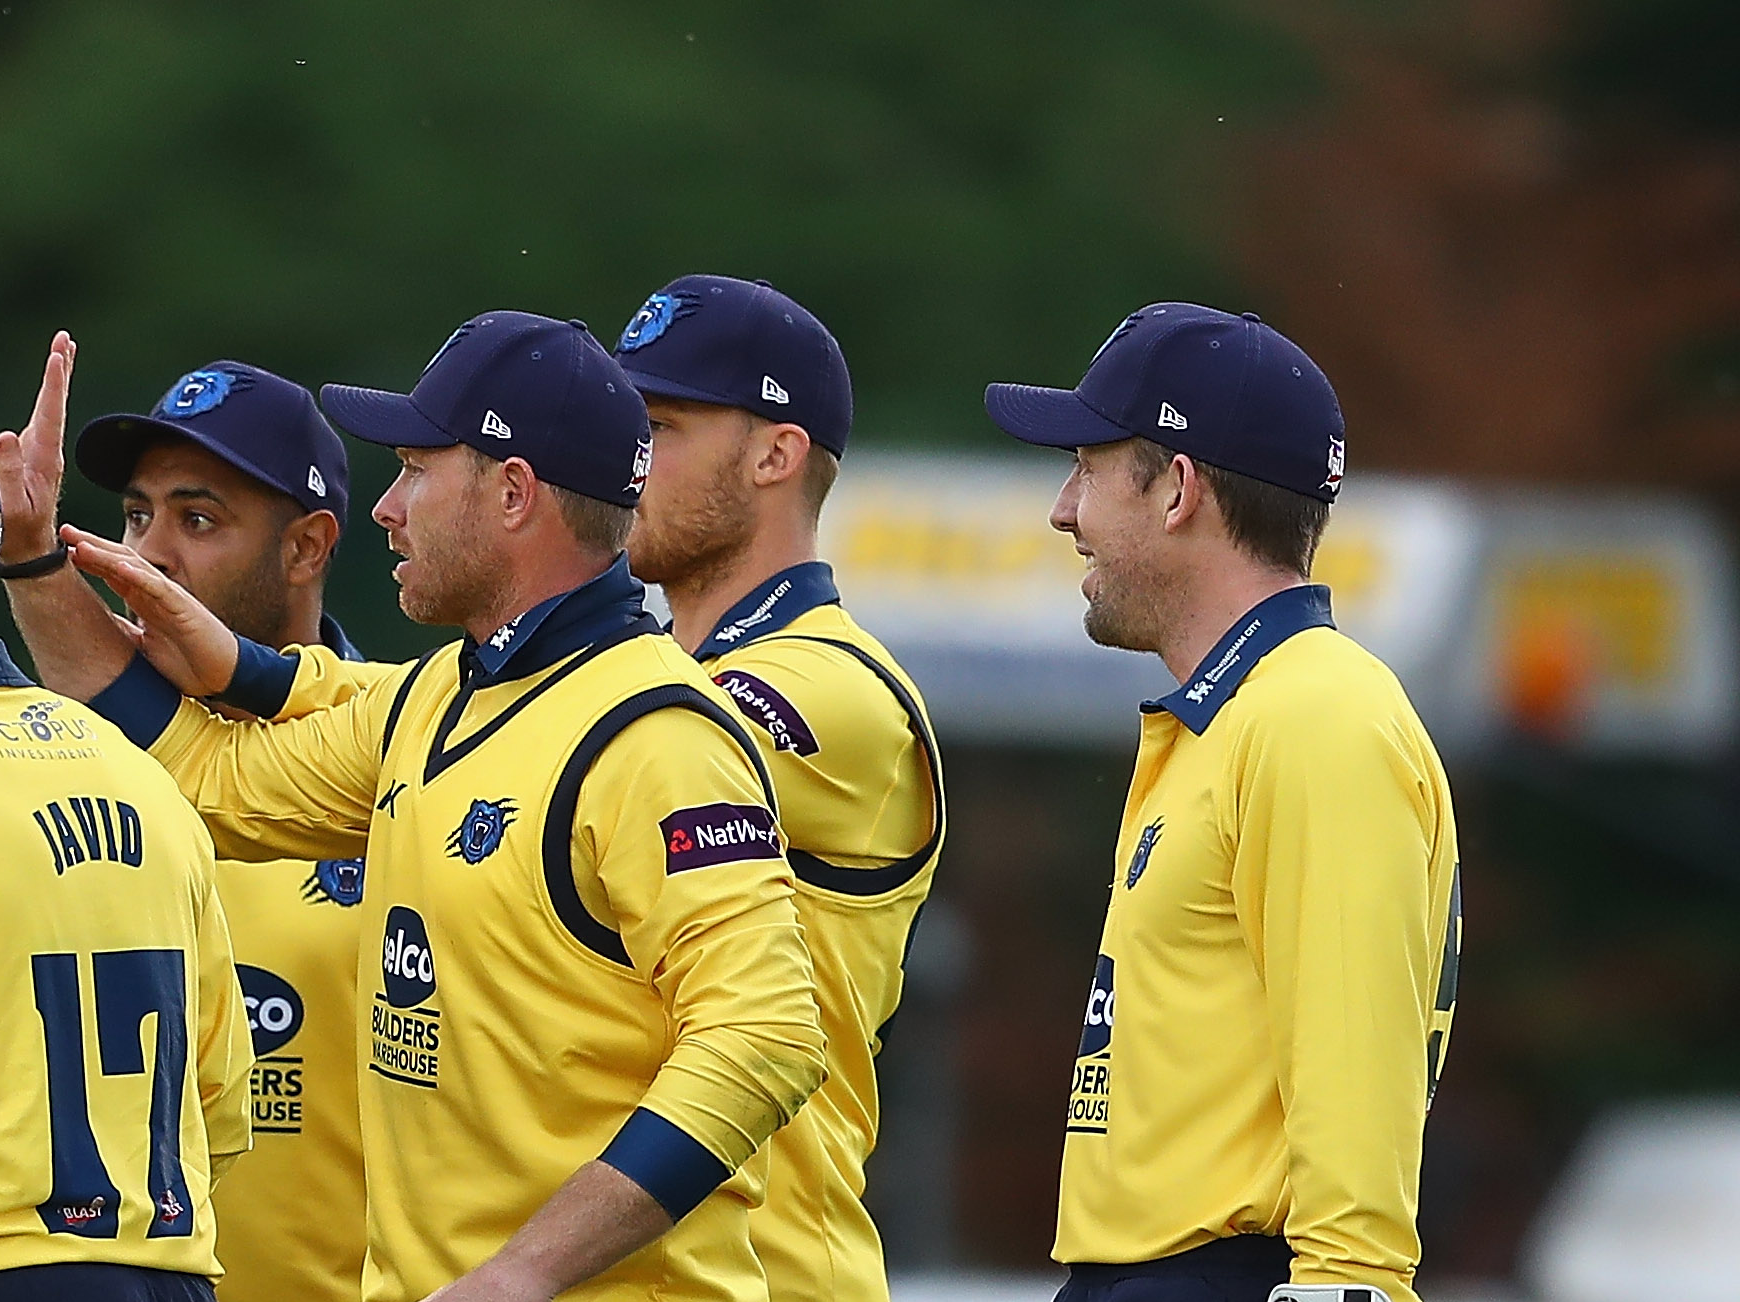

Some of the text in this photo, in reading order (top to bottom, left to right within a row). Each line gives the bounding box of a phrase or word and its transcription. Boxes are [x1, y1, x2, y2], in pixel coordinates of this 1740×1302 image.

[1243, 619, 1262, 637] CITY
[32, 797, 146, 877] JAVID
[30, 948, 194, 1239] 17
[63, 1206, 102, 1219] BLAST
